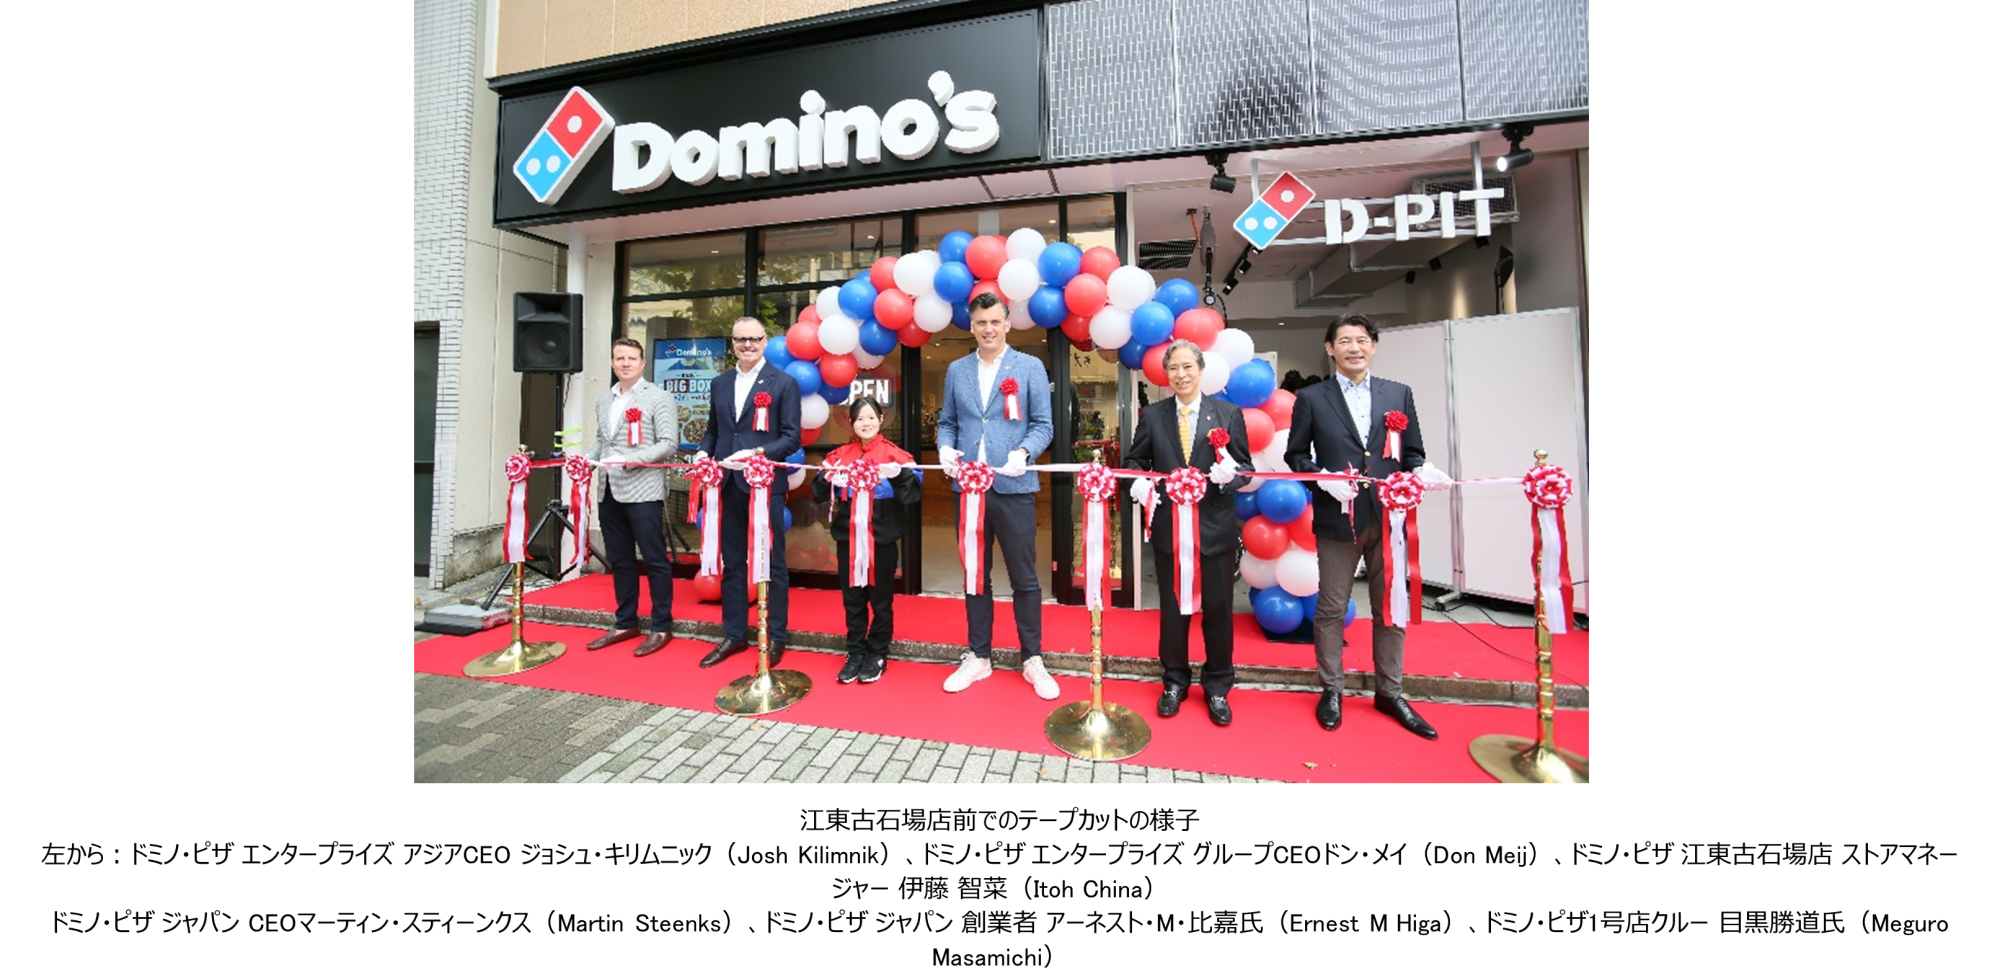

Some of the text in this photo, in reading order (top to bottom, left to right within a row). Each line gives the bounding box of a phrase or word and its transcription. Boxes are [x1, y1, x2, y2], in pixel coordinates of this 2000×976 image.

[611, 69, 998, 195] Domino's
[1324, 187, 1505, 245] D-PIT
[665, 379, 712, 393] BIG BOX
[838, 378, 890, 406] PEN
